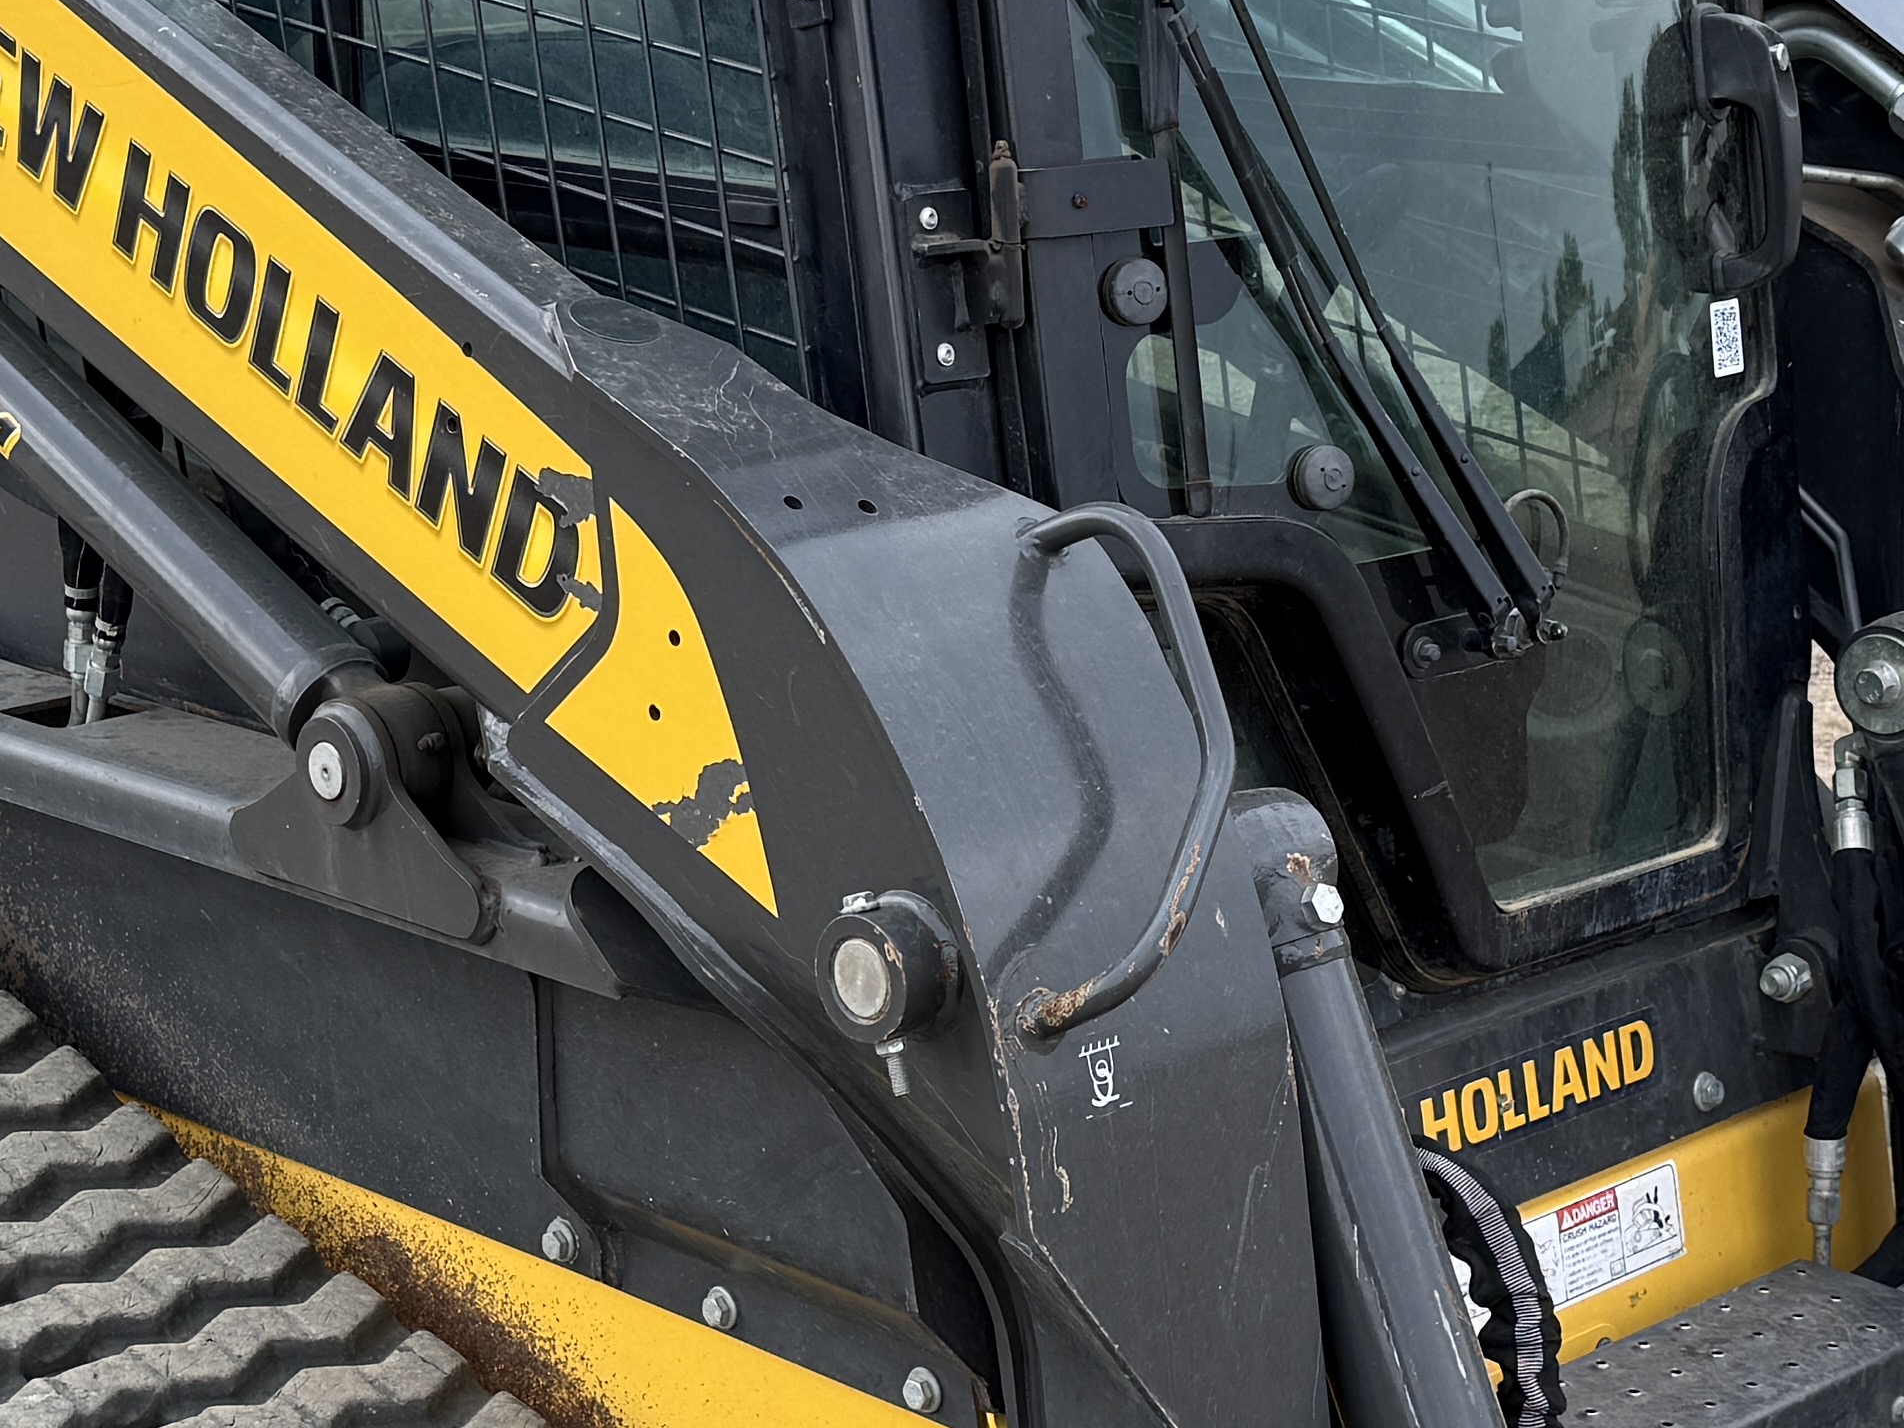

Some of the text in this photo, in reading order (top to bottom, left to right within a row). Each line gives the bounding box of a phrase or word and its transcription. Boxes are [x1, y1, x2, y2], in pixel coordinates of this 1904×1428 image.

[111, 138, 582, 622] HOLLAND
[1419, 1019, 1655, 1153] HOLLAND
[1562, 1213, 1617, 1244] CRUSH HAZARD
[1571, 1191, 1615, 1227] DANGER
